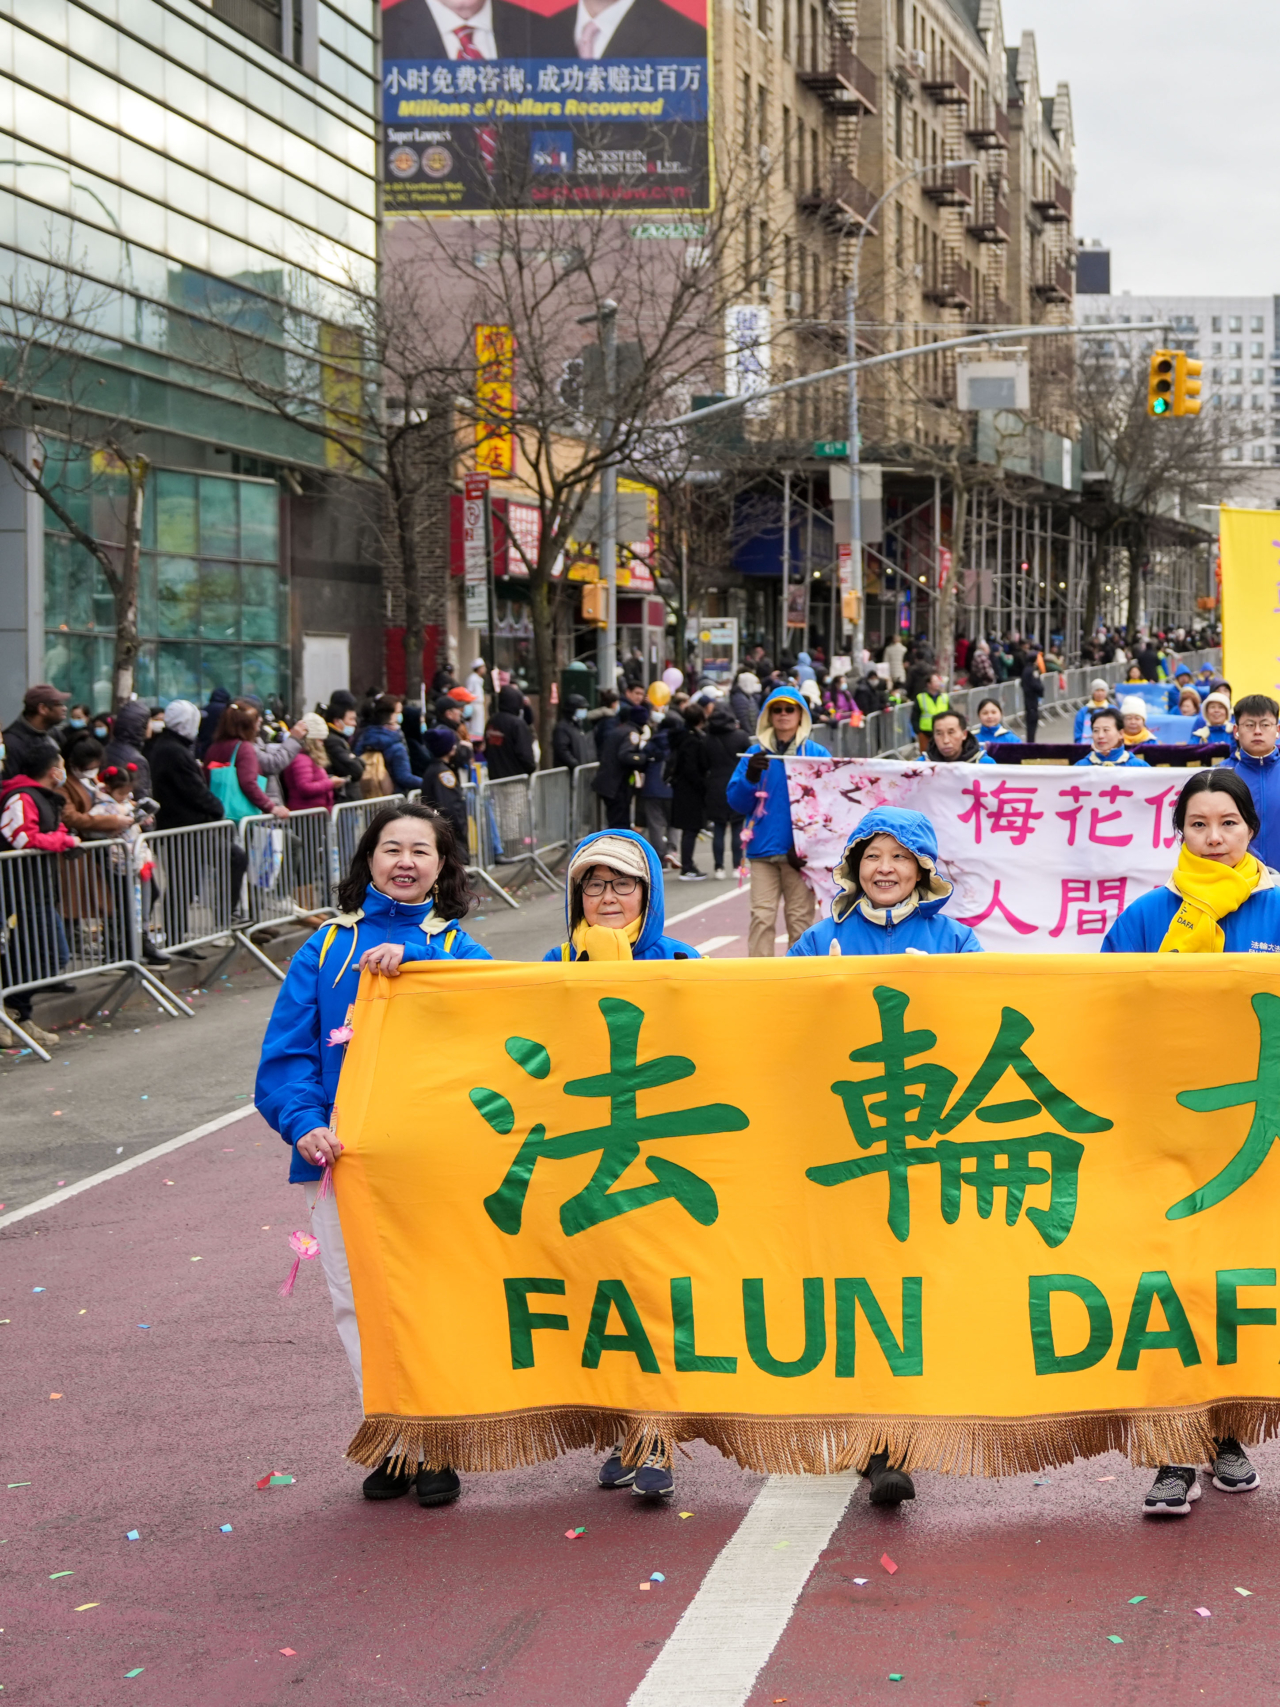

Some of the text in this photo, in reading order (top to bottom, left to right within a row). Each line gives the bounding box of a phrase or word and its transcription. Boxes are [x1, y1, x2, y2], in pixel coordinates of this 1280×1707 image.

[398, 98, 665, 117] Millions of Dollars Recovered
[1176, 916, 1195, 931] DAFA
[502, 1276, 925, 1378] FALUN
